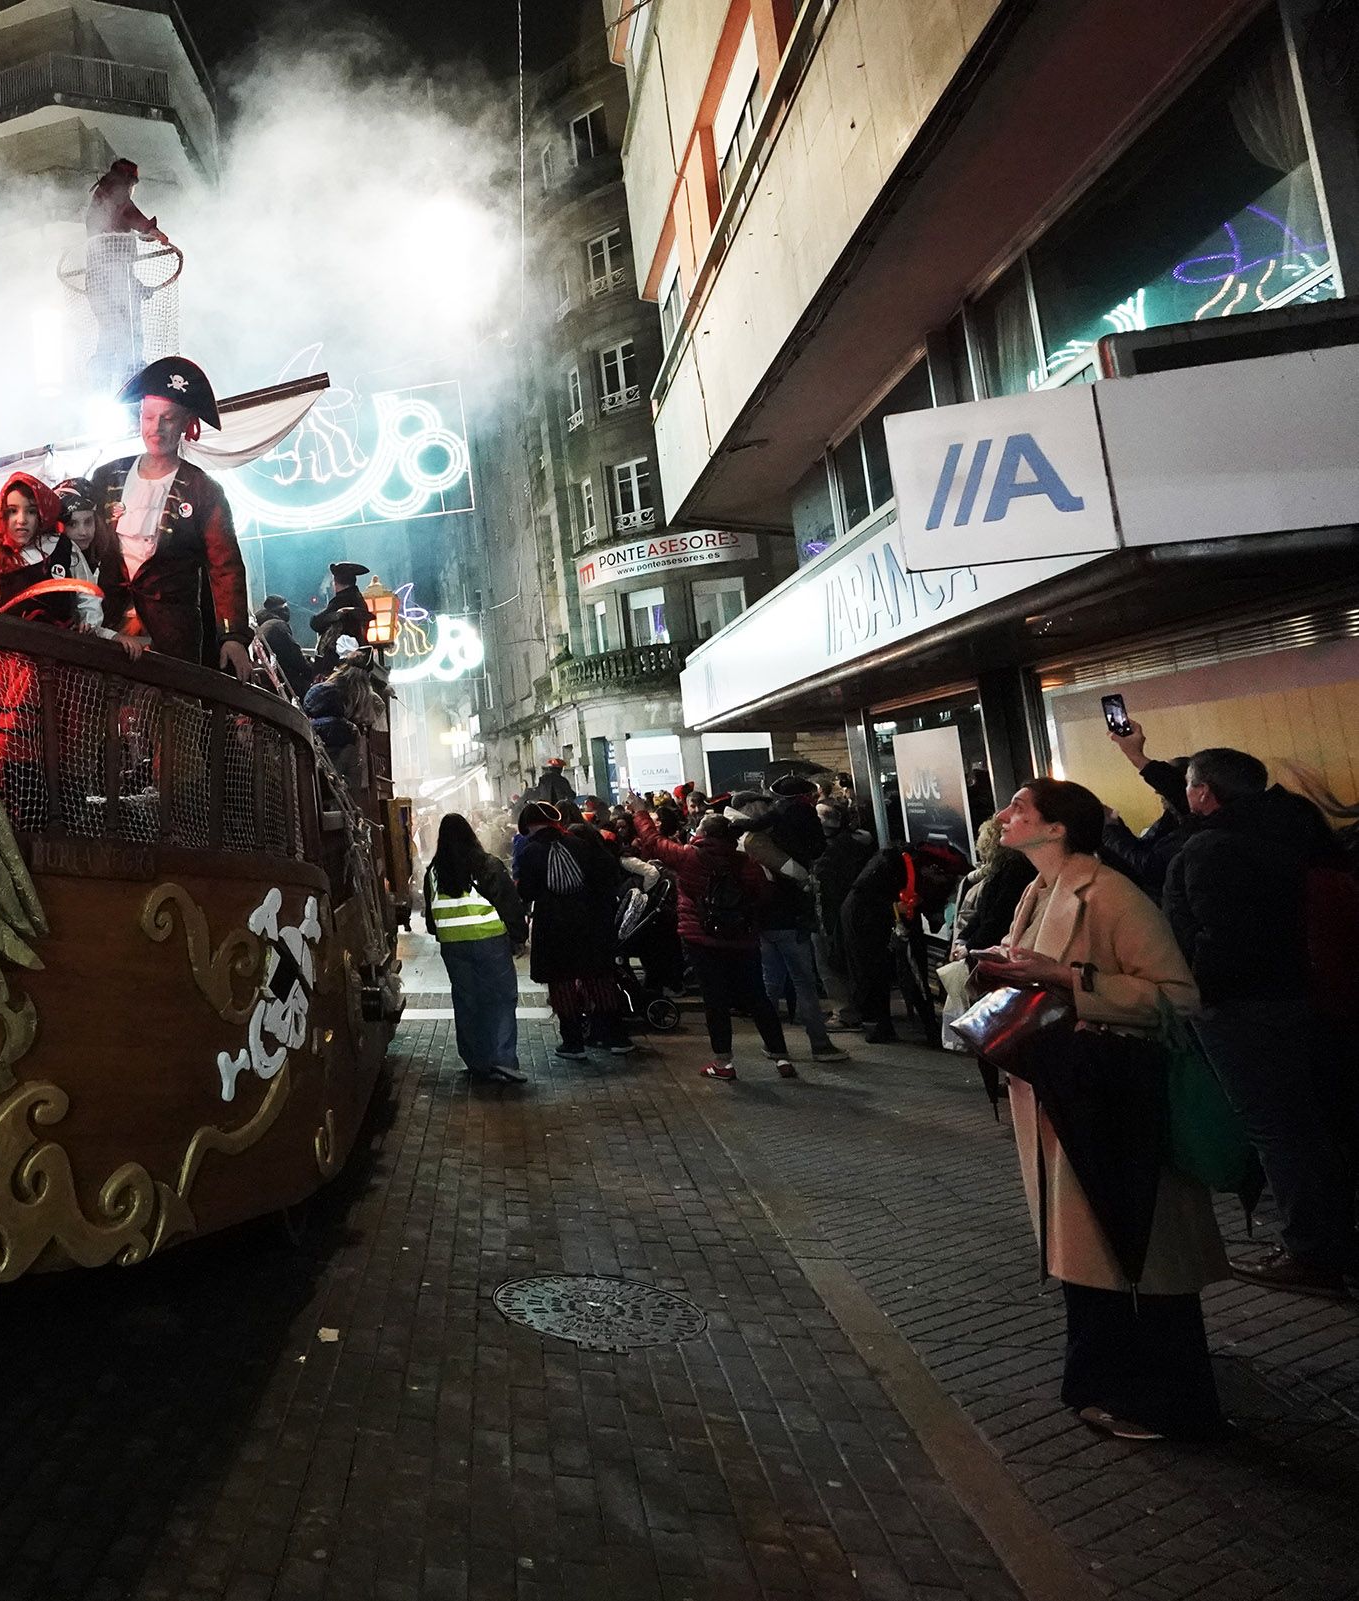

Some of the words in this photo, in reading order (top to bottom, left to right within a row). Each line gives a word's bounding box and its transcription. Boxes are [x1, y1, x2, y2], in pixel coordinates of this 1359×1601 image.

[598, 532, 740, 569] PONTEASESORES
[616, 551, 721, 576] www.ponteasesores.es
[641, 766, 670, 776] CULMIA
